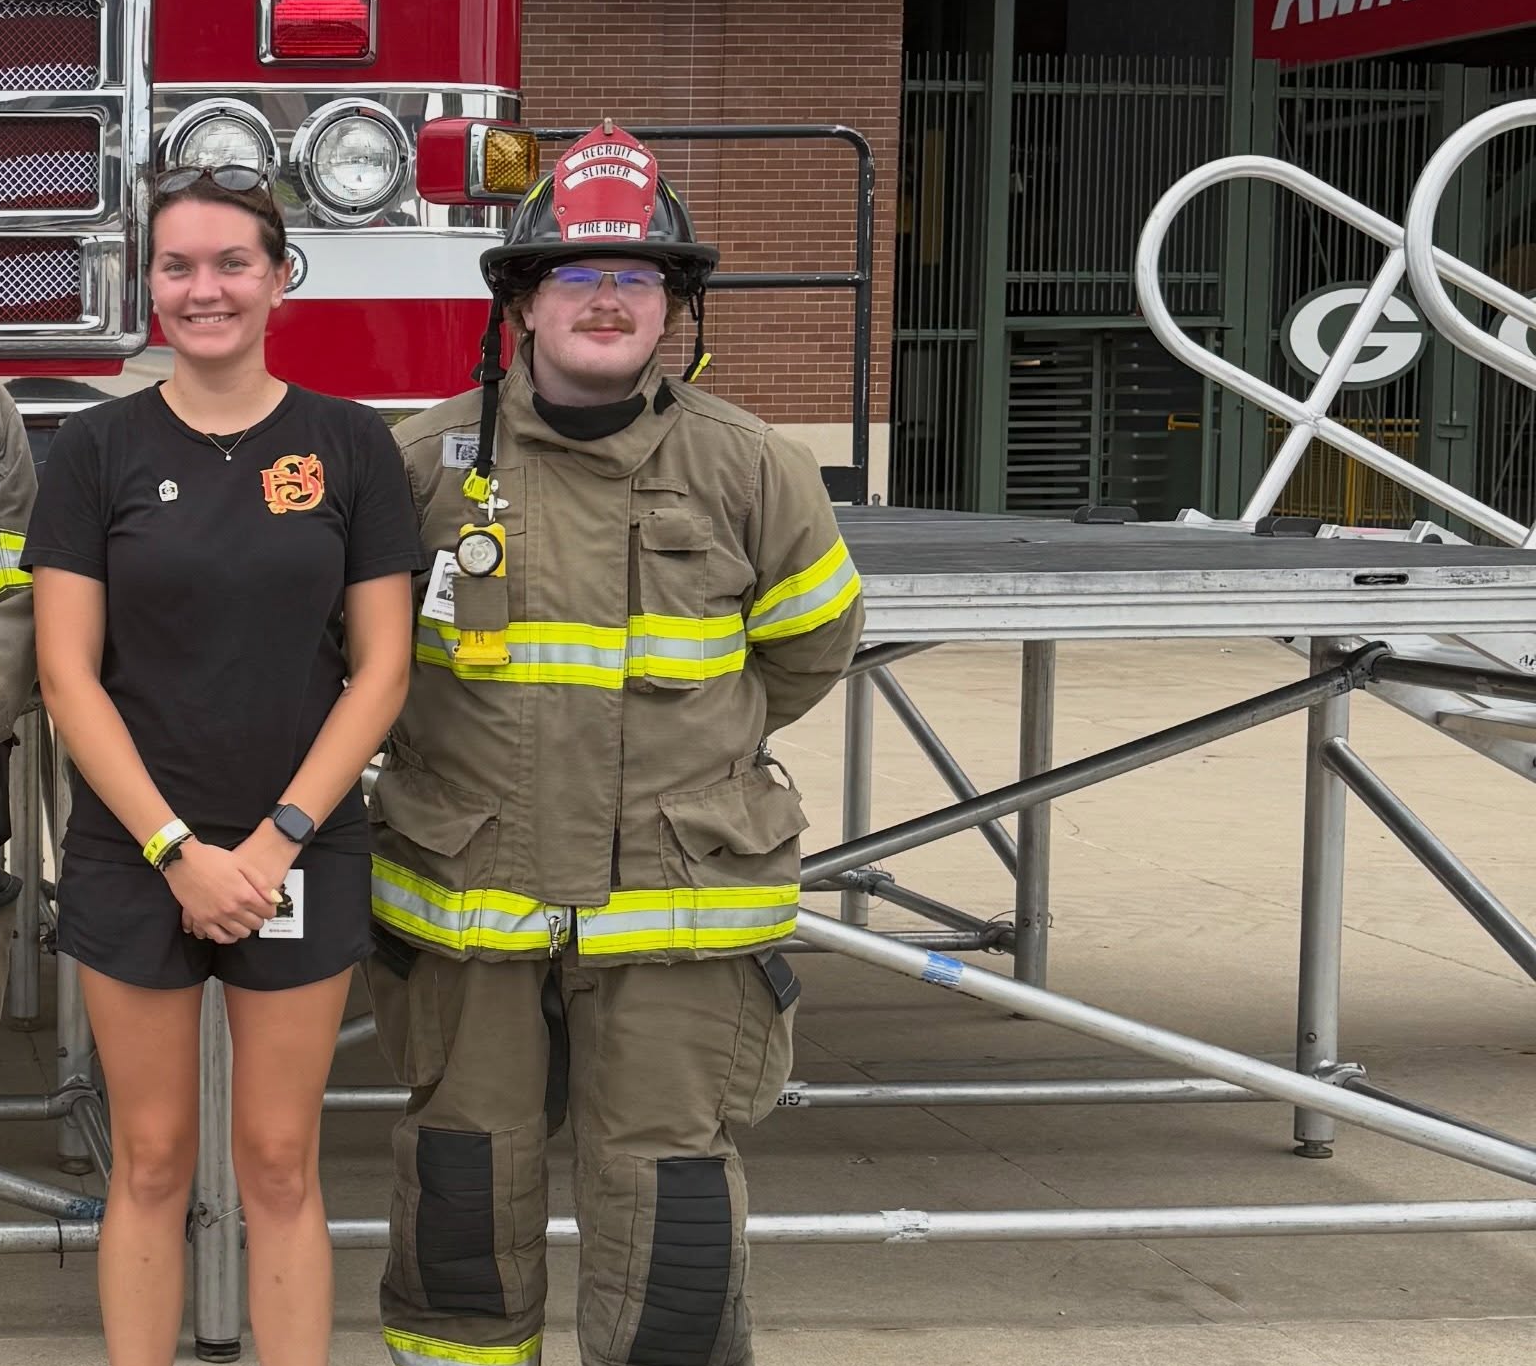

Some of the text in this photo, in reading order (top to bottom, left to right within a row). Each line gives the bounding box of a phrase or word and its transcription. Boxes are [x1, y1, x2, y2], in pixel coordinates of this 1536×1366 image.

[581, 145, 634, 160] RECRUIT
[581, 163, 631, 179] SLINGER
[577, 221, 632, 234] FIRE DEPT
